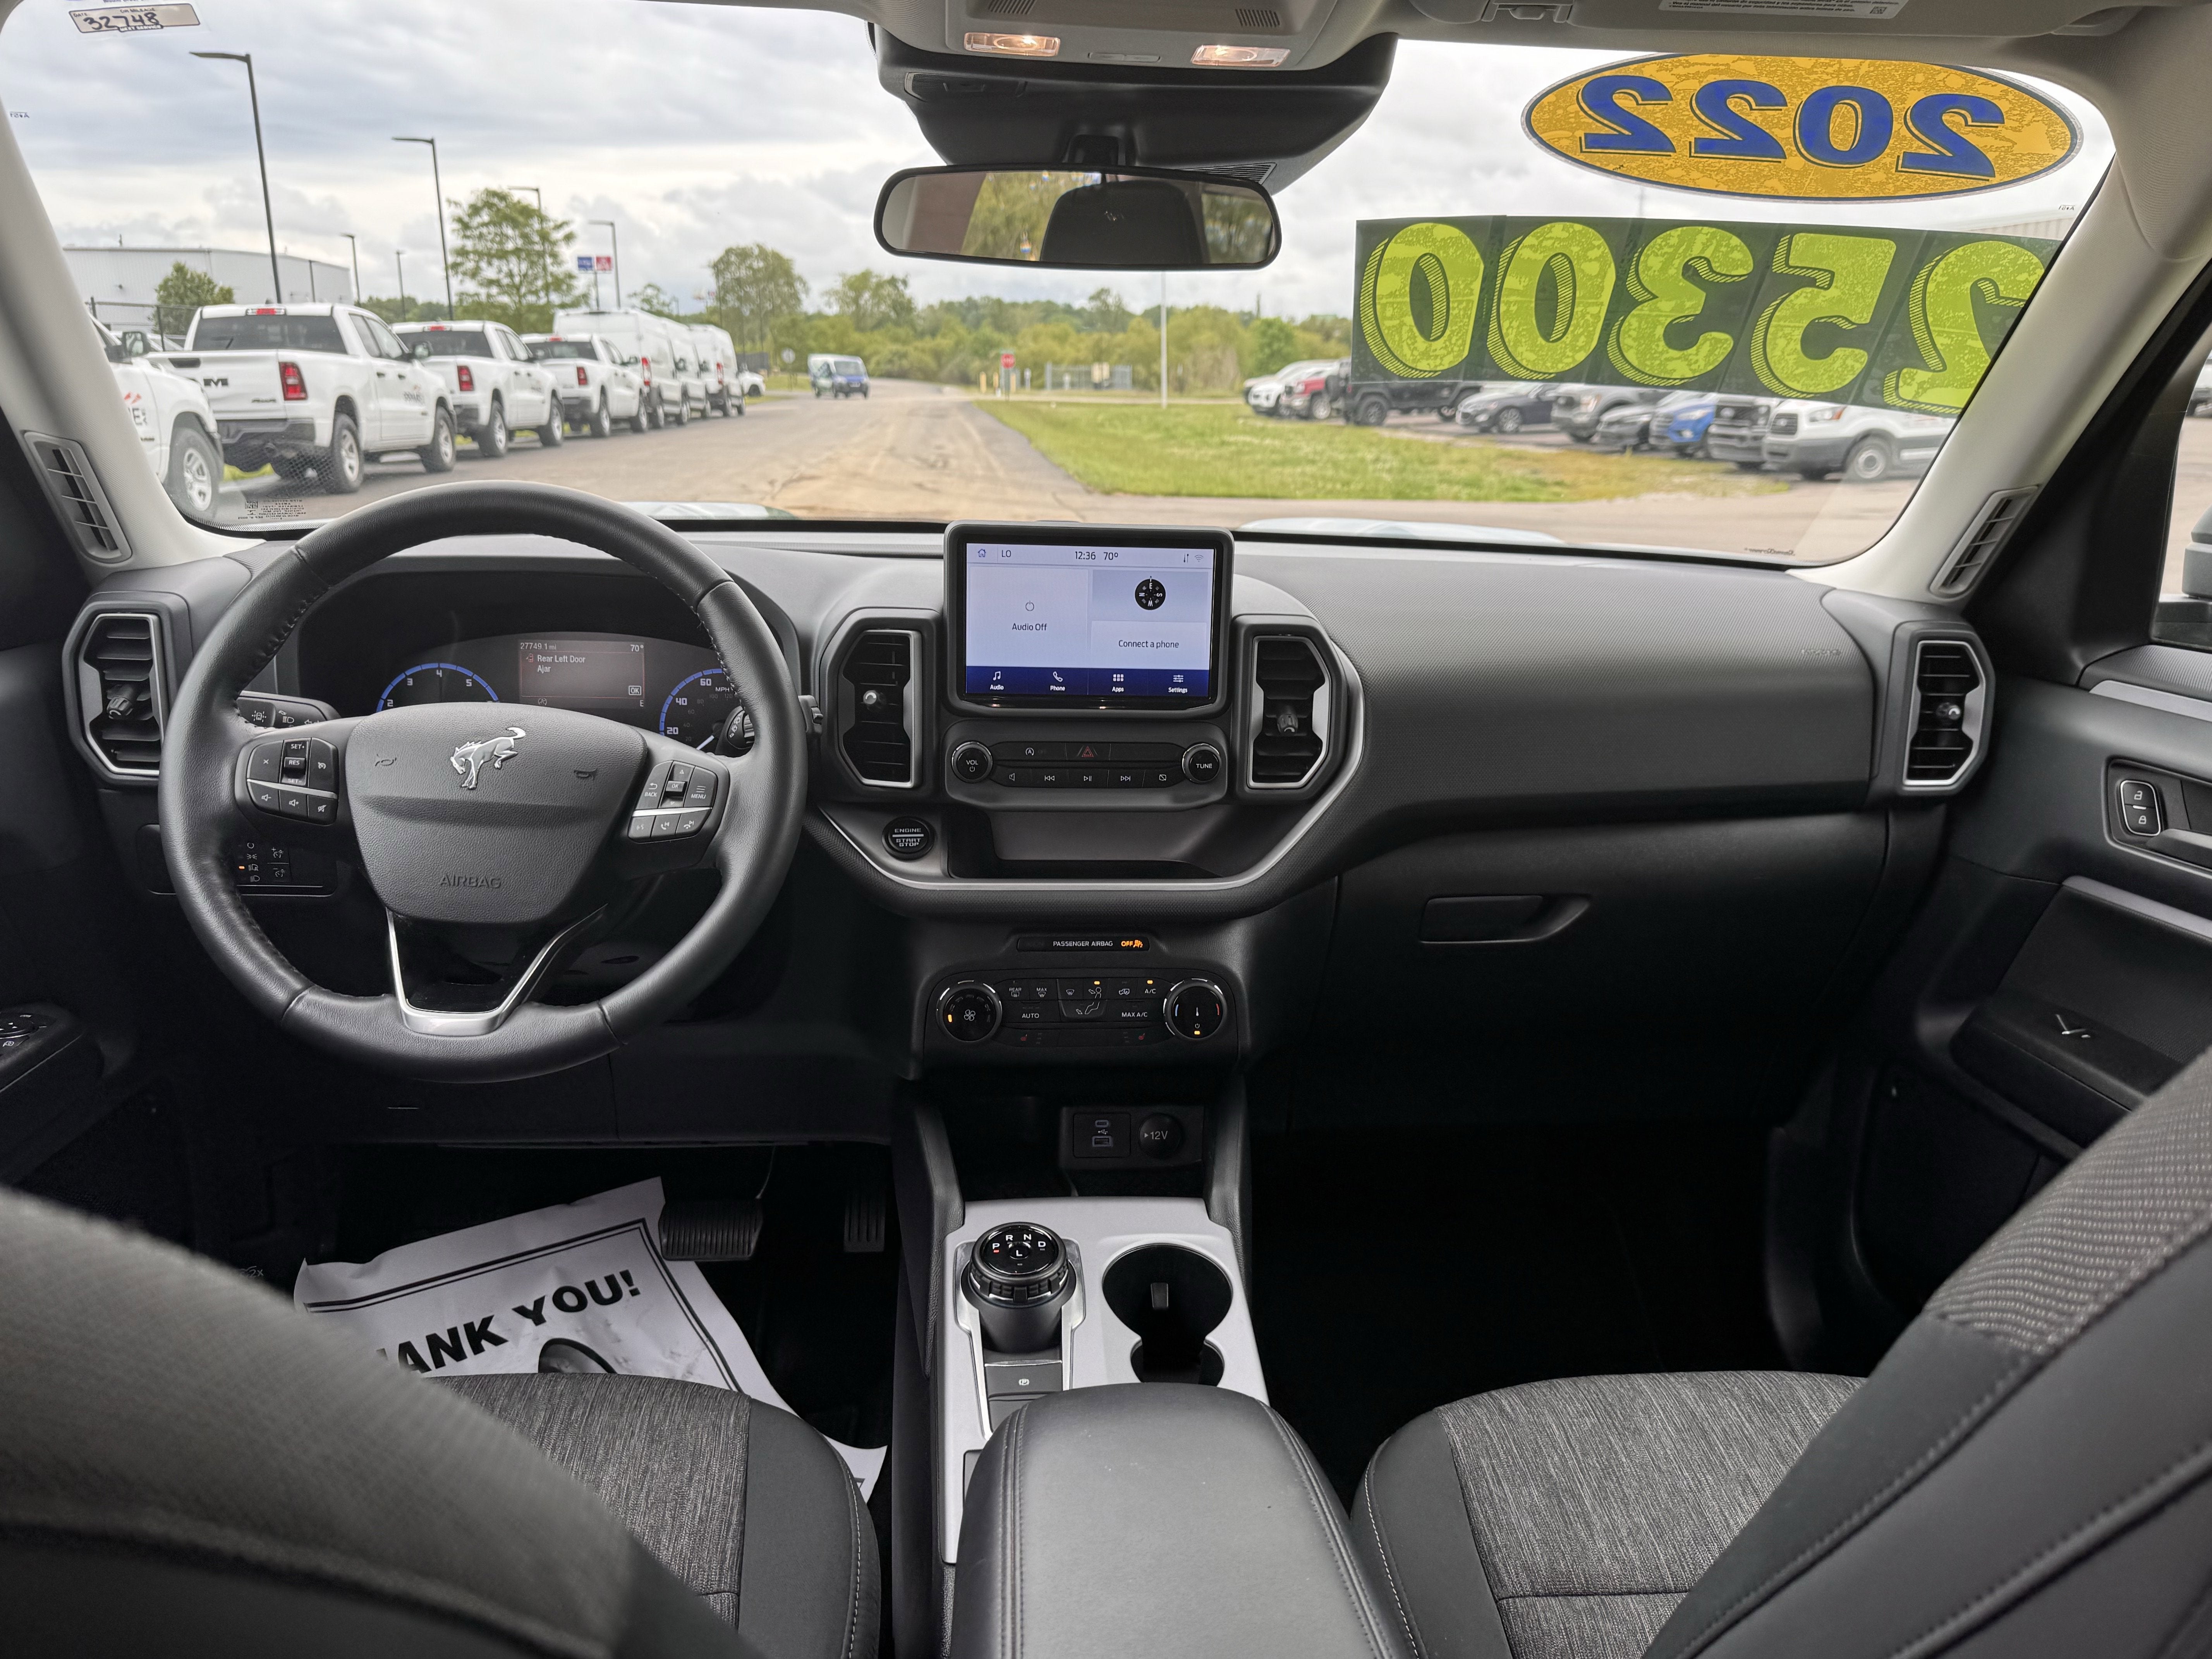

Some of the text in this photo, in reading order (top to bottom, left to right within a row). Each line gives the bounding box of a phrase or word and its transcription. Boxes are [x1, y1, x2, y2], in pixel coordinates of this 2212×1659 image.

[83, 12, 159, 30] 32748
[1075, 551, 1096, 560] 12:36
[1012, 622, 1047, 631] Audio Off
[1118, 640, 1148, 648] Connect
[1156, 640, 1179, 650] phone
[538, 654, 553, 663] Rear
[436, 669, 442, 677] 4
[538, 665, 551, 673] Ajar
[440, 874, 501, 889] AIRBAG
[1150, 1130, 1168, 1140] 12V
[376, 1269, 641, 1374] ANK YOU!
